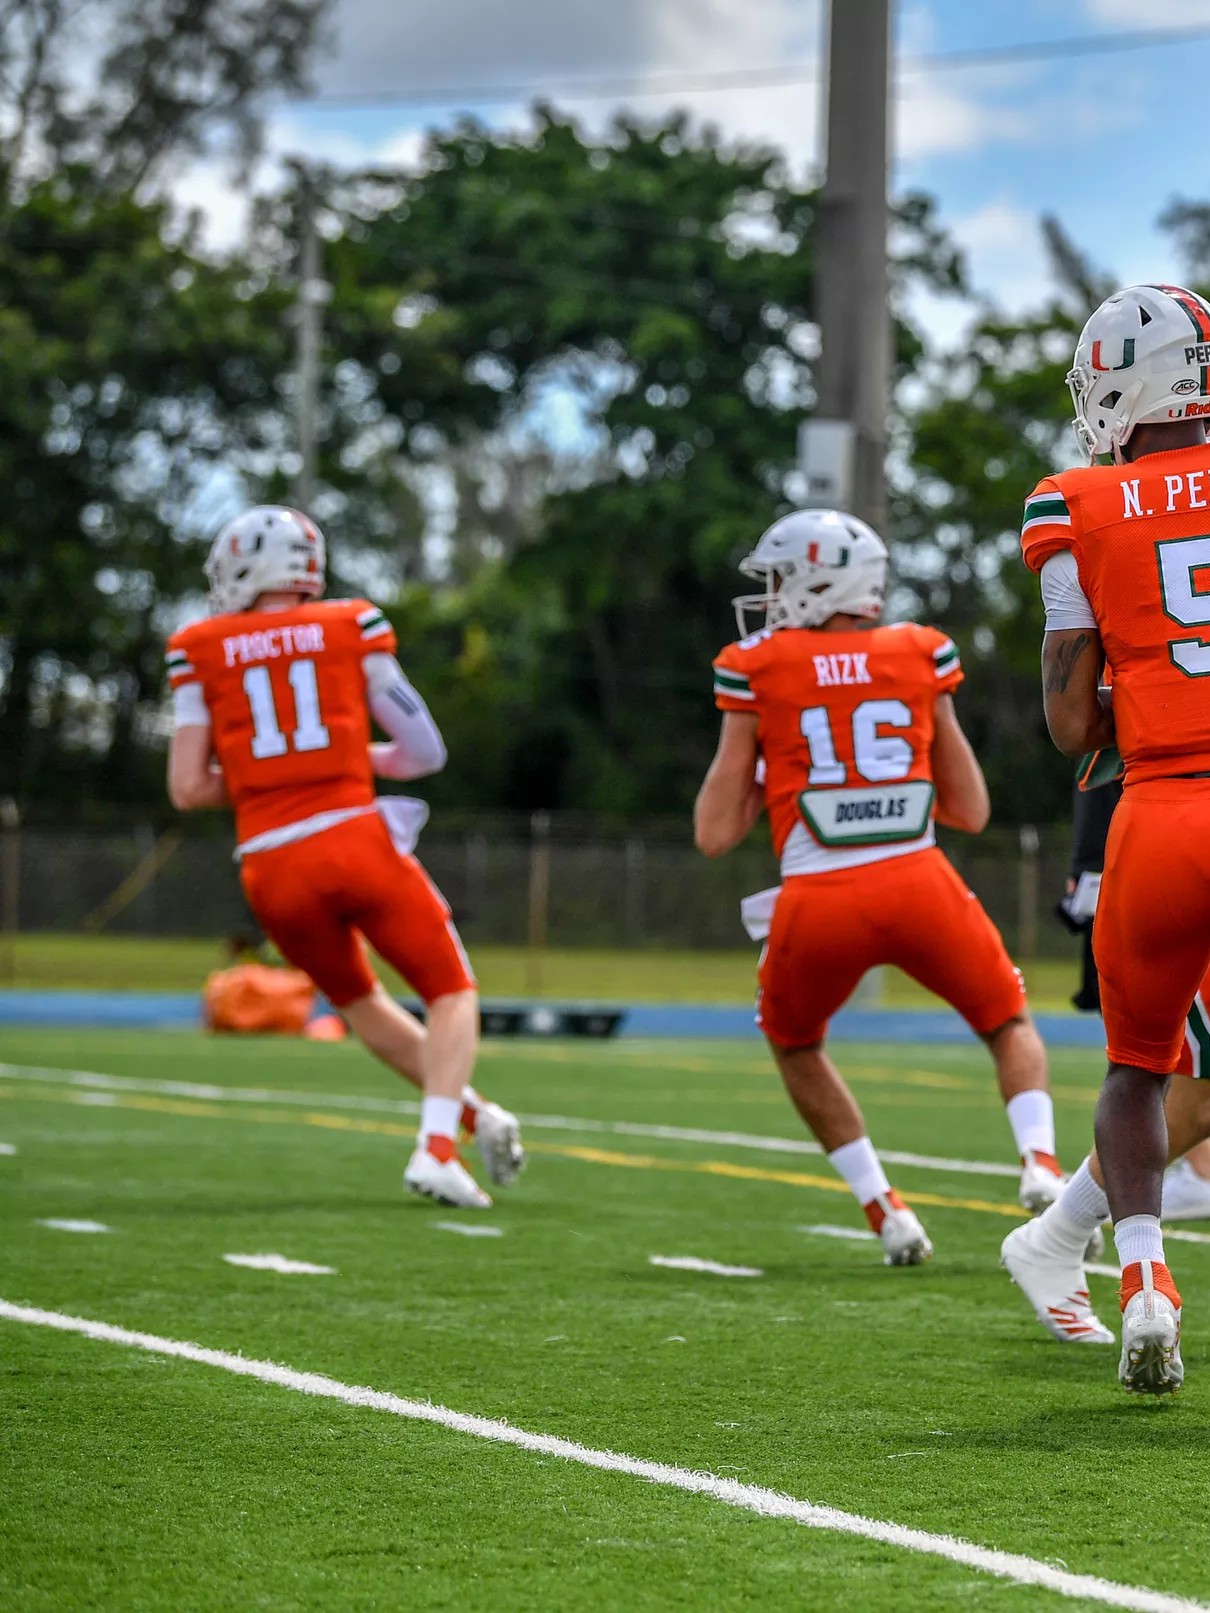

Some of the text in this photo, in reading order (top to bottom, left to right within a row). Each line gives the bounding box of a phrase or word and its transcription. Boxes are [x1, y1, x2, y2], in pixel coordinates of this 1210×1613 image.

[1175, 382, 1196, 391] ACC
[1120, 479, 1154, 518] N.
[222, 623, 325, 667] PROCTOR
[812, 653, 872, 687] RIZK
[242, 659, 330, 759] 11
[800, 699, 913, 785] 16
[835, 797, 908, 824] DOUGLAS
